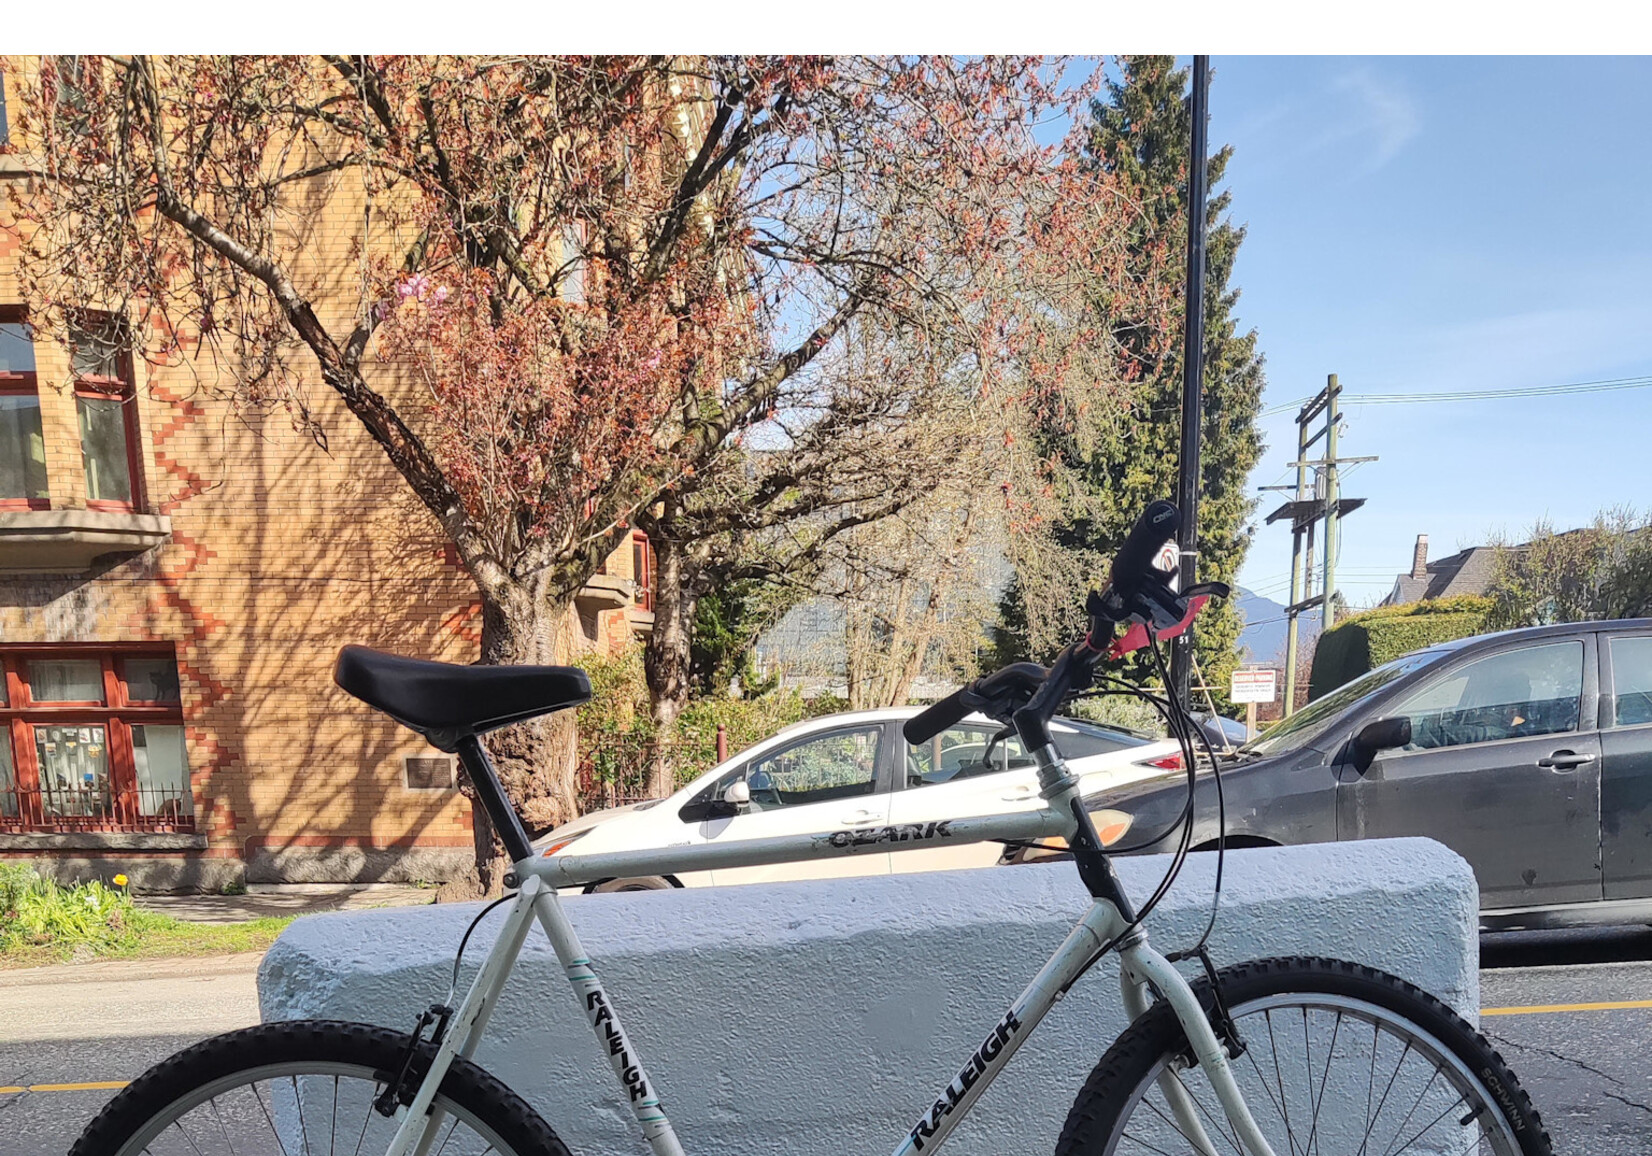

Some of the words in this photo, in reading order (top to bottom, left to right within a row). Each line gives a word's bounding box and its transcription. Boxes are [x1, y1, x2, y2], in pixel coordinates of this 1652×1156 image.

[828, 820, 953, 848] OZARK
[586, 990, 648, 1102] RALEIGH
[910, 1010, 1023, 1152] RALEIGH
[1480, 1067, 1526, 1132] SCHWINN
